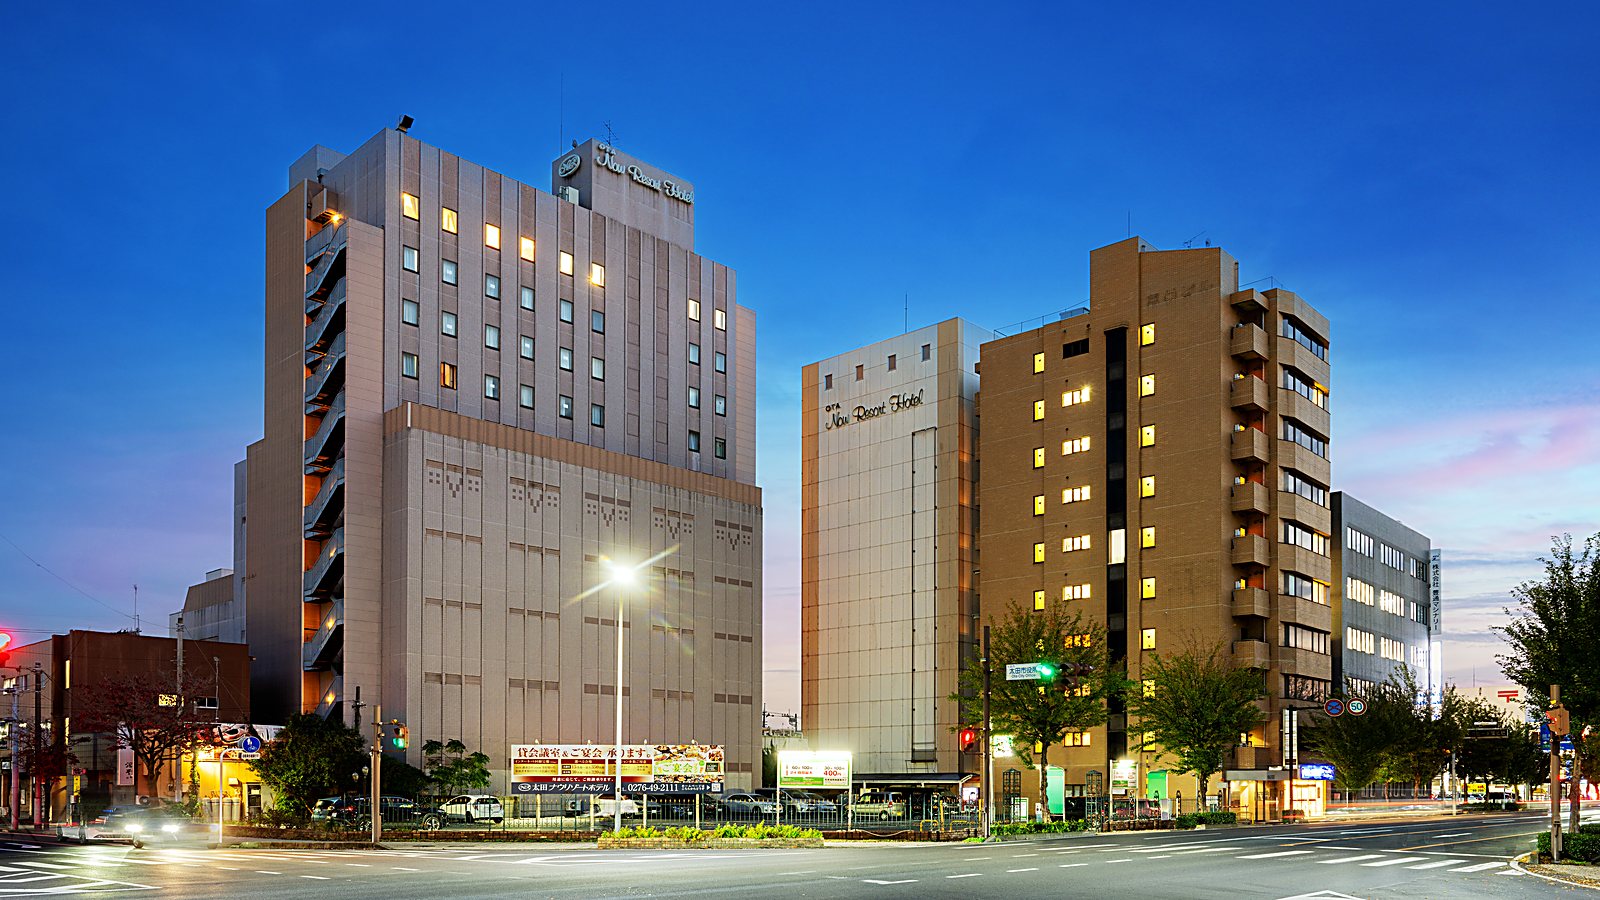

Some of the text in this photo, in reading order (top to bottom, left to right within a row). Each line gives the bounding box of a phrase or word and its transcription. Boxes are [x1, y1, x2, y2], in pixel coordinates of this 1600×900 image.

[598, 143, 617, 156] OTA
[596, 153, 626, 175] Now
[628, 164, 662, 192] Resort
[663, 179, 695, 204] Hotel
[825, 402, 841, 412] OTA
[825, 388, 924, 430] Now Resort Hotel
[1350, 702, 1363, 711] 50
[627, 783, 679, 792] 0276-49-2111
